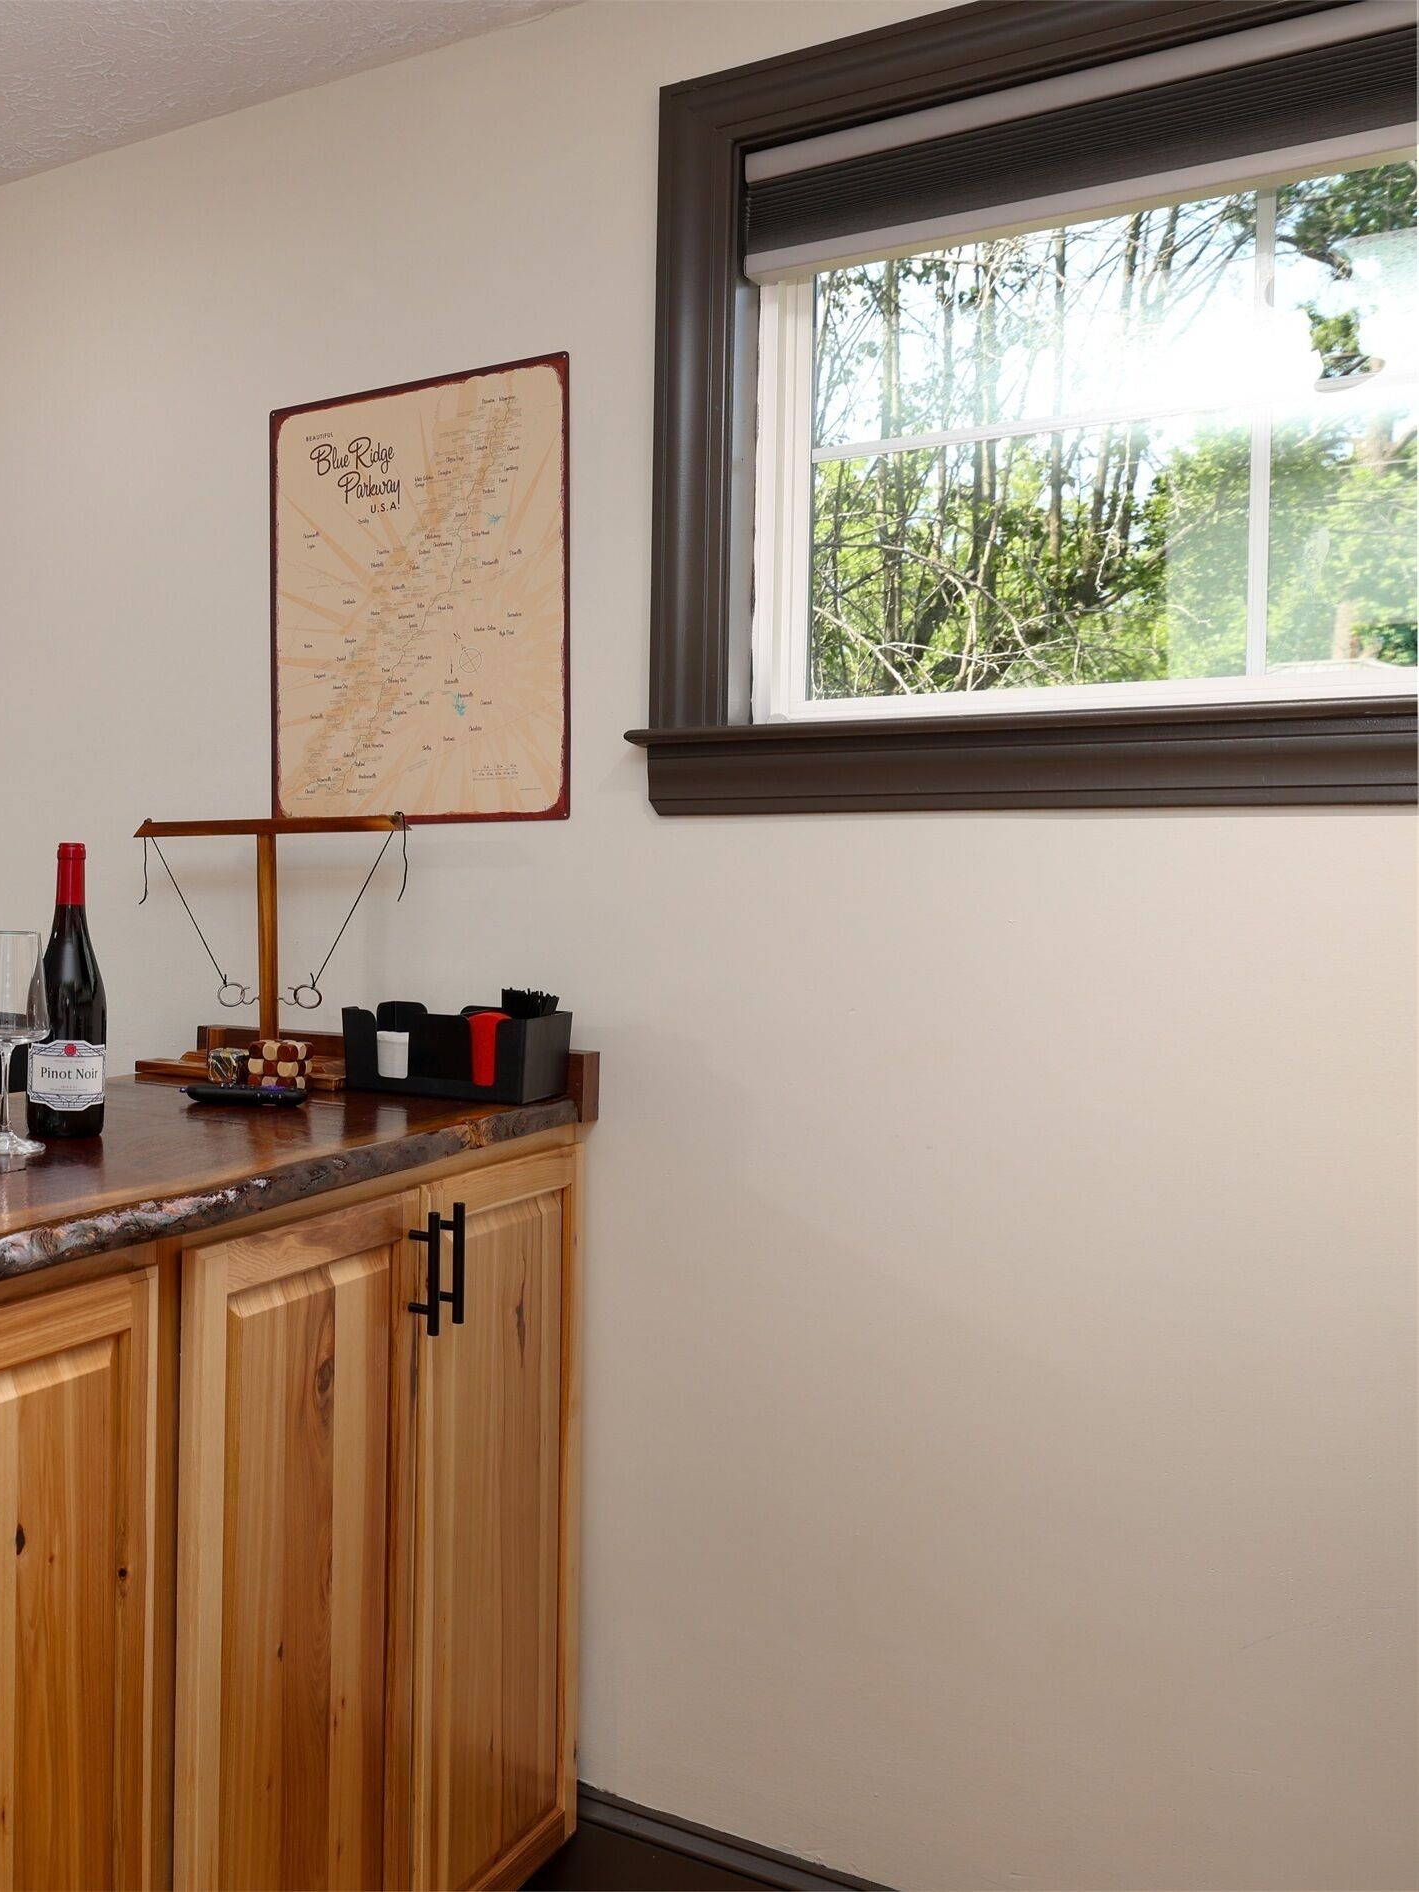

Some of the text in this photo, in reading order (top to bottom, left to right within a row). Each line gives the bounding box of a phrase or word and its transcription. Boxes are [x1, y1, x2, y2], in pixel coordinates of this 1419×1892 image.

[306, 432, 333, 442] BEAUTIFUL
[310, 437, 394, 475] Blue Ridge
[338, 471, 400, 504] Parkway
[371, 502, 400, 513] U.S.A.
[40, 1066, 98, 1080] Pinot Noir
